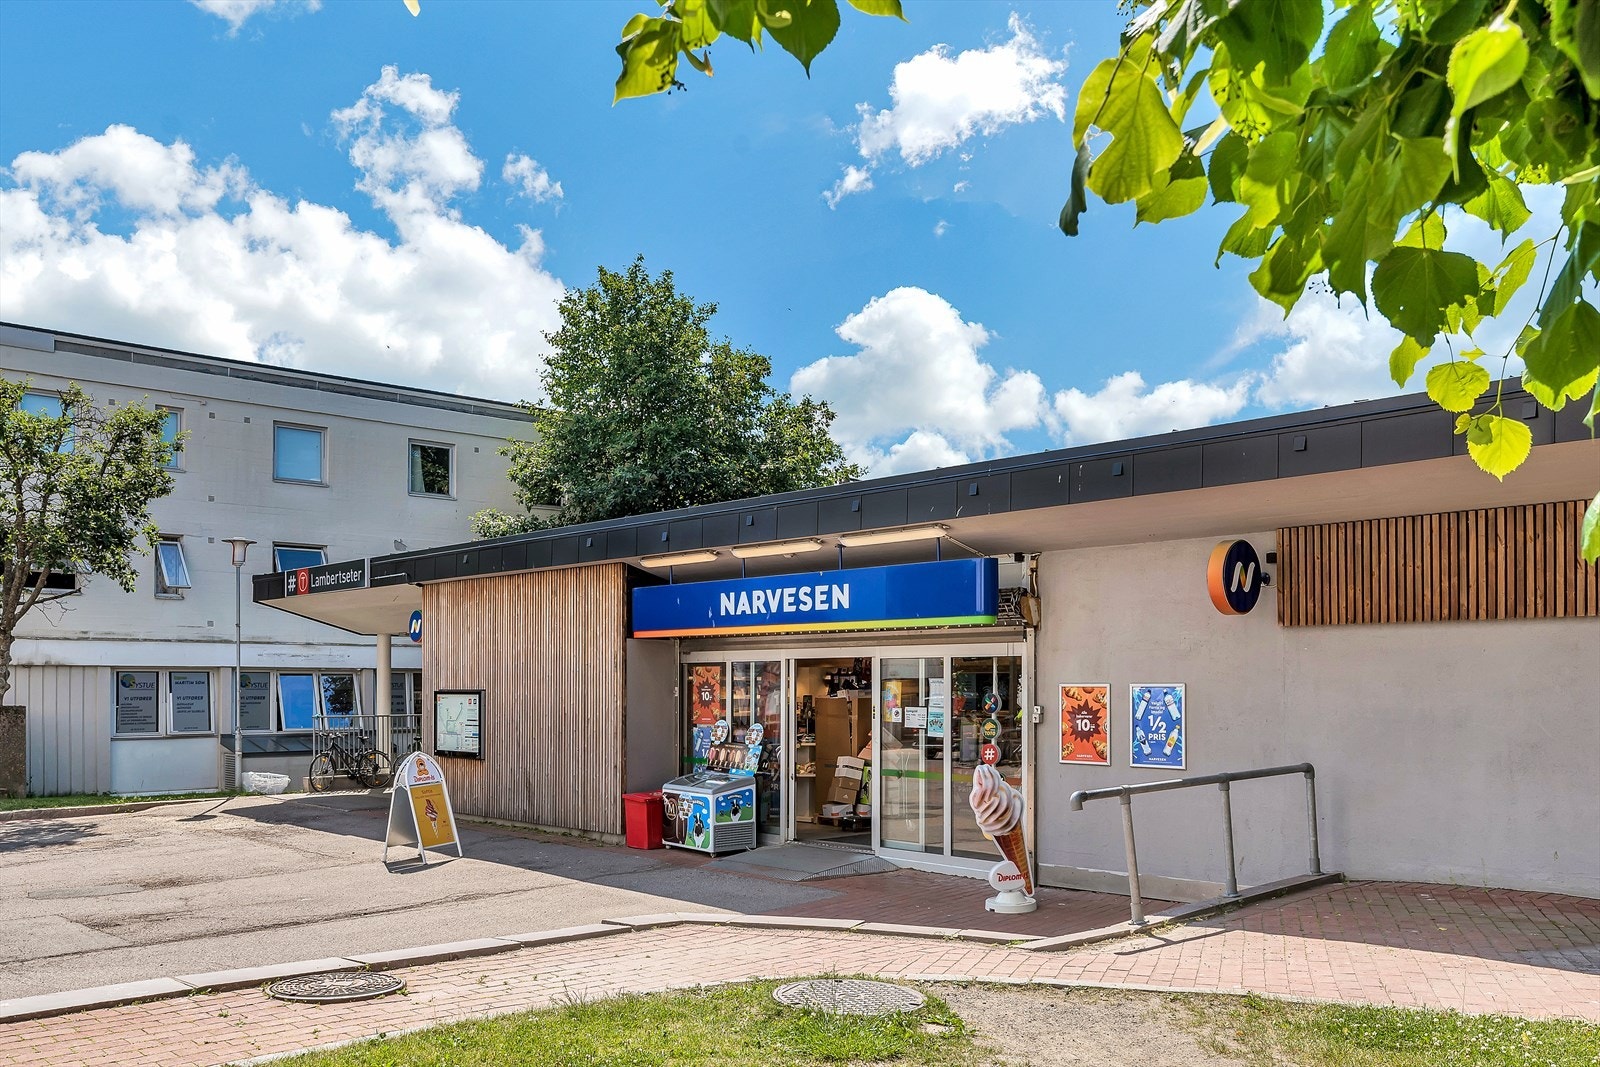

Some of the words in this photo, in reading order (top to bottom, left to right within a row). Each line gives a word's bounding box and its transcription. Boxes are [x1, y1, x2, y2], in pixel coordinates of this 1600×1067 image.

[310, 569, 362, 587] Lambertseter
[1231, 561, 1256, 593] N
[720, 583, 850, 616] NARVESEN
[410, 619, 422, 633] N
[1148, 715, 1167, 733] 1/2
